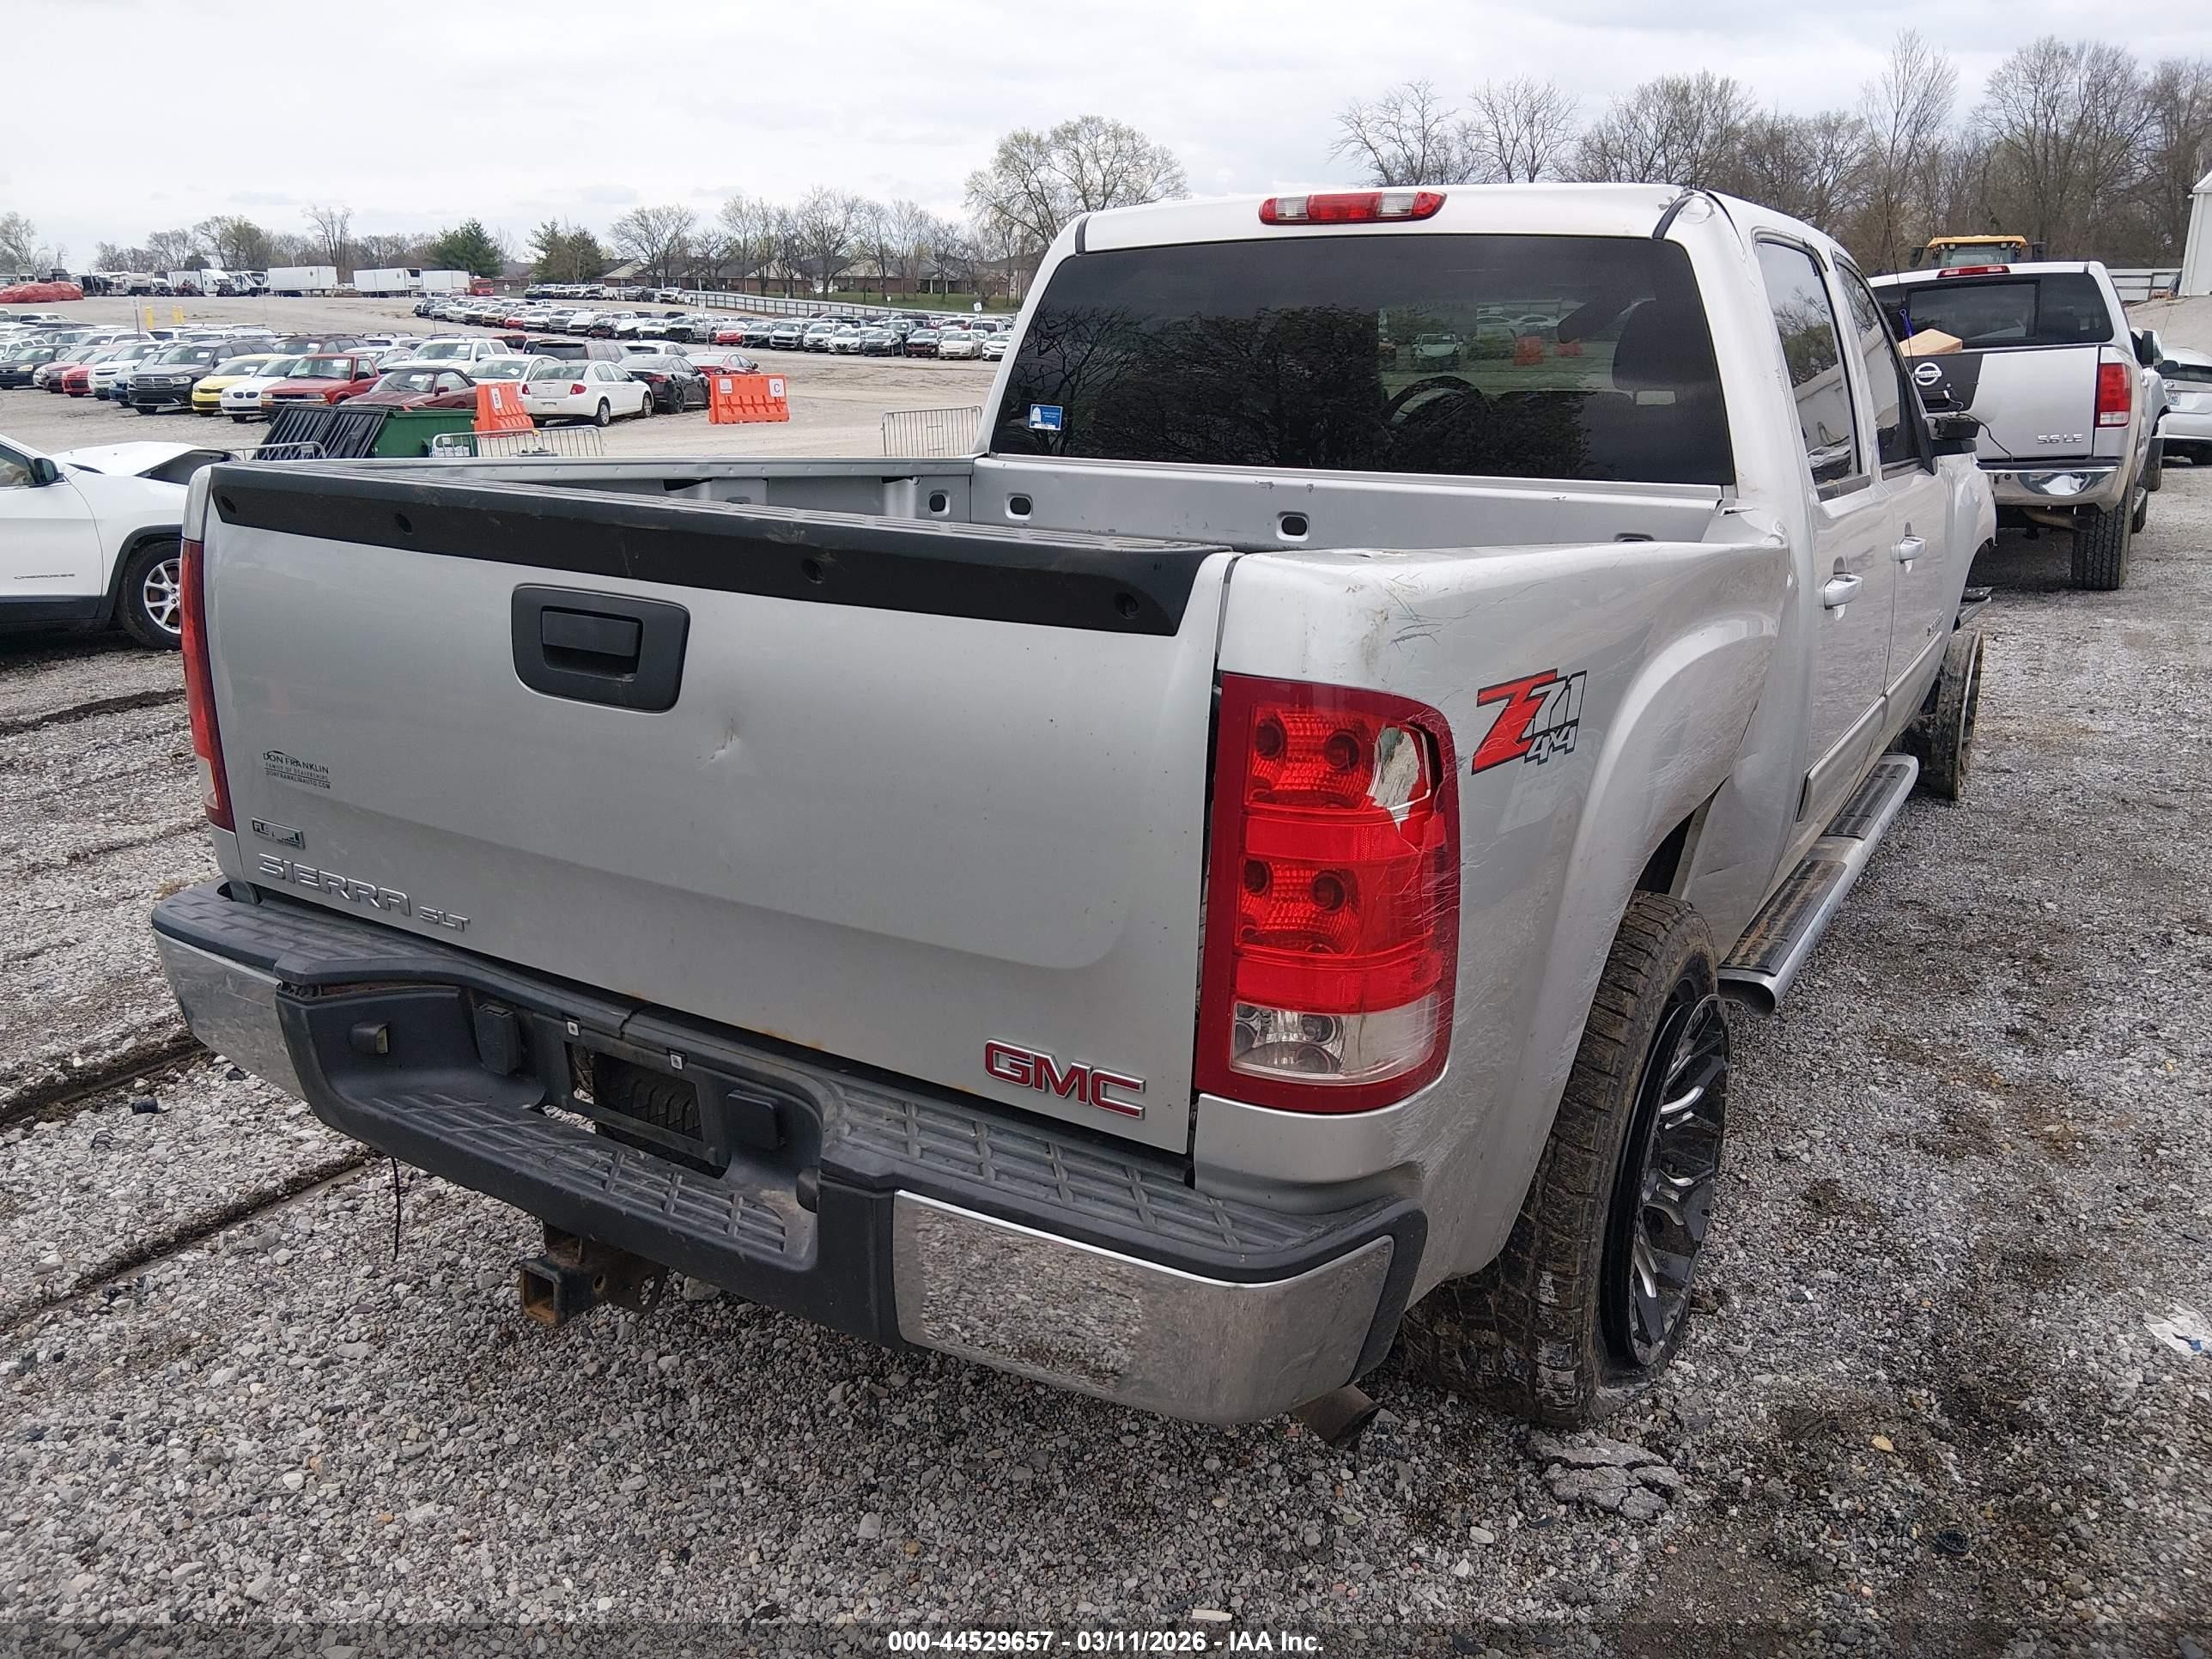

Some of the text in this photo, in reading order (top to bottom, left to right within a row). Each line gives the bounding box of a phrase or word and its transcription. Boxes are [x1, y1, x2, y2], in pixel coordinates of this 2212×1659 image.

[774, 383, 781, 393] C
[2063, 433, 2083, 443] LE
[1471, 667, 1588, 775] Z71
[263, 752, 329, 775] DON FRANKLIN
[258, 852, 471, 933] SIERRA SLT
[985, 1037, 1146, 1120] GMC
